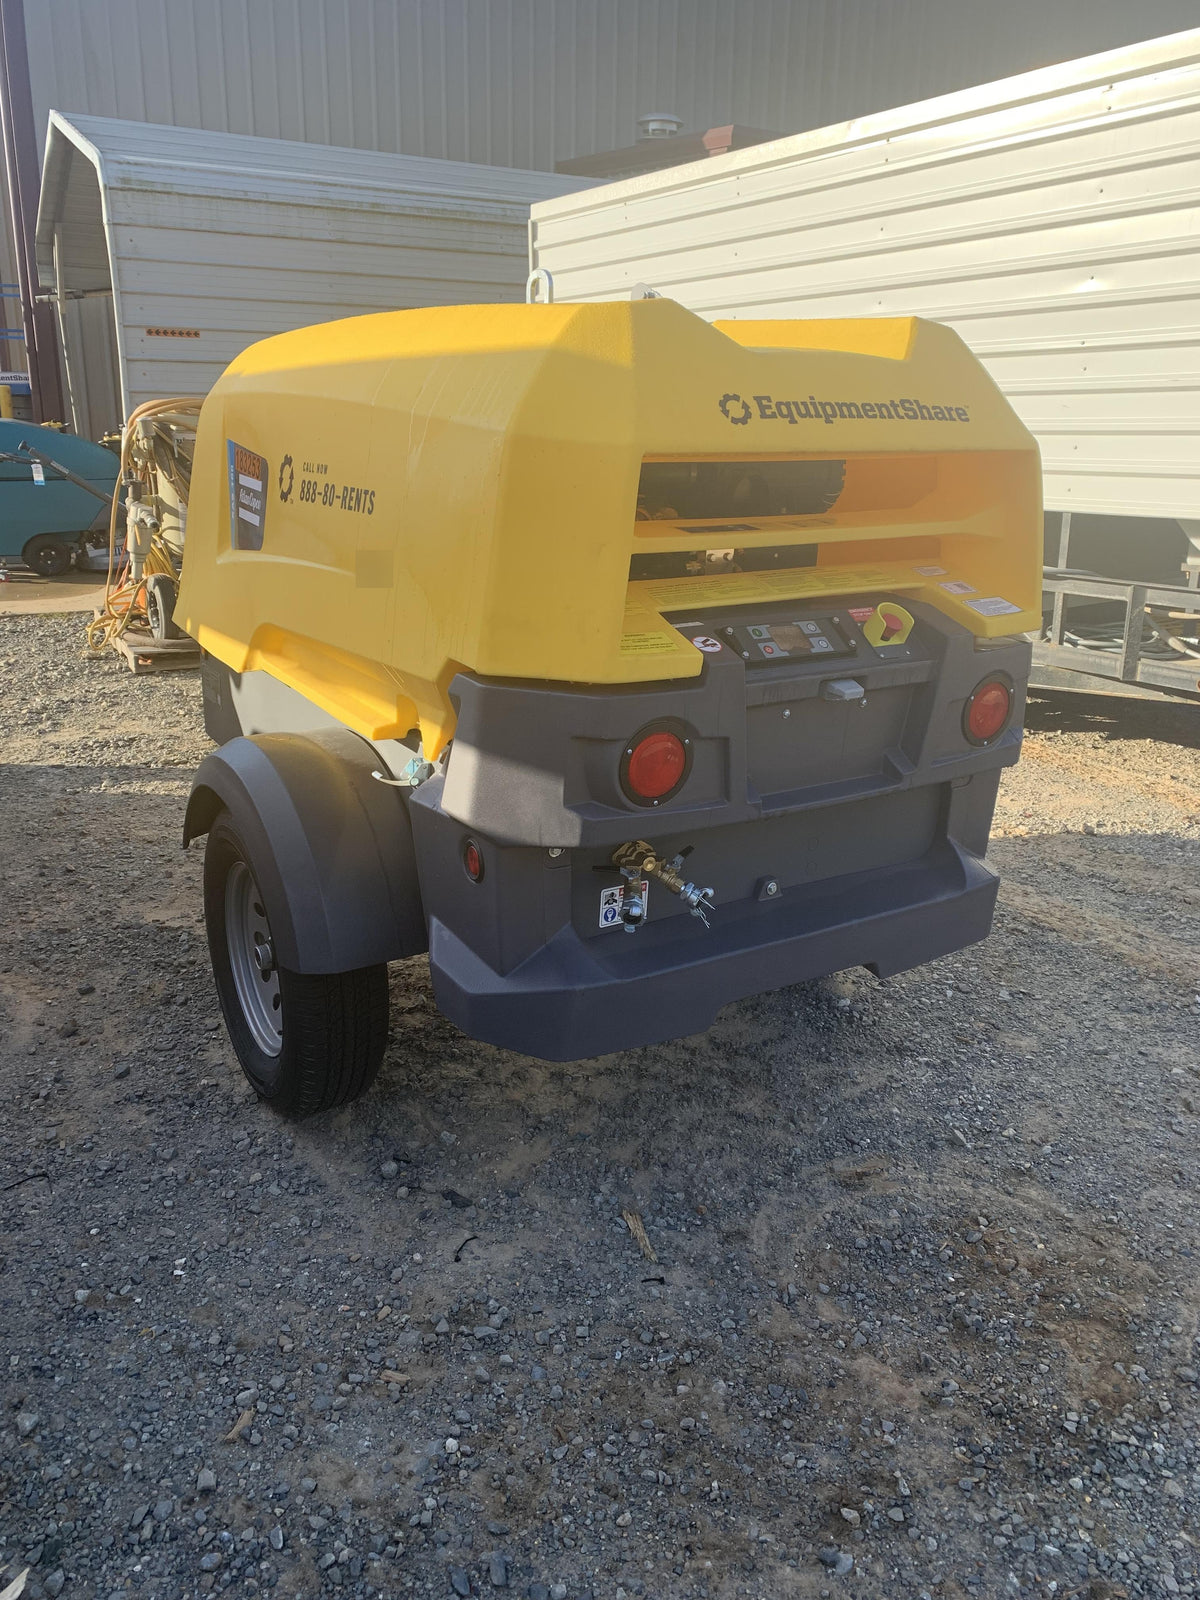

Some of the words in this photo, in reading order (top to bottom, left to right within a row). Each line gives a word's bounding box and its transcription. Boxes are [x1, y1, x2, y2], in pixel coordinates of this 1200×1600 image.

[753, 395, 970, 425] EquipmentShare
[235, 448, 261, 479] 183253
[303, 462, 315, 474] CALL
[317, 464, 328, 475] NOW
[300, 479, 376, 515] 888-80-RENTS
